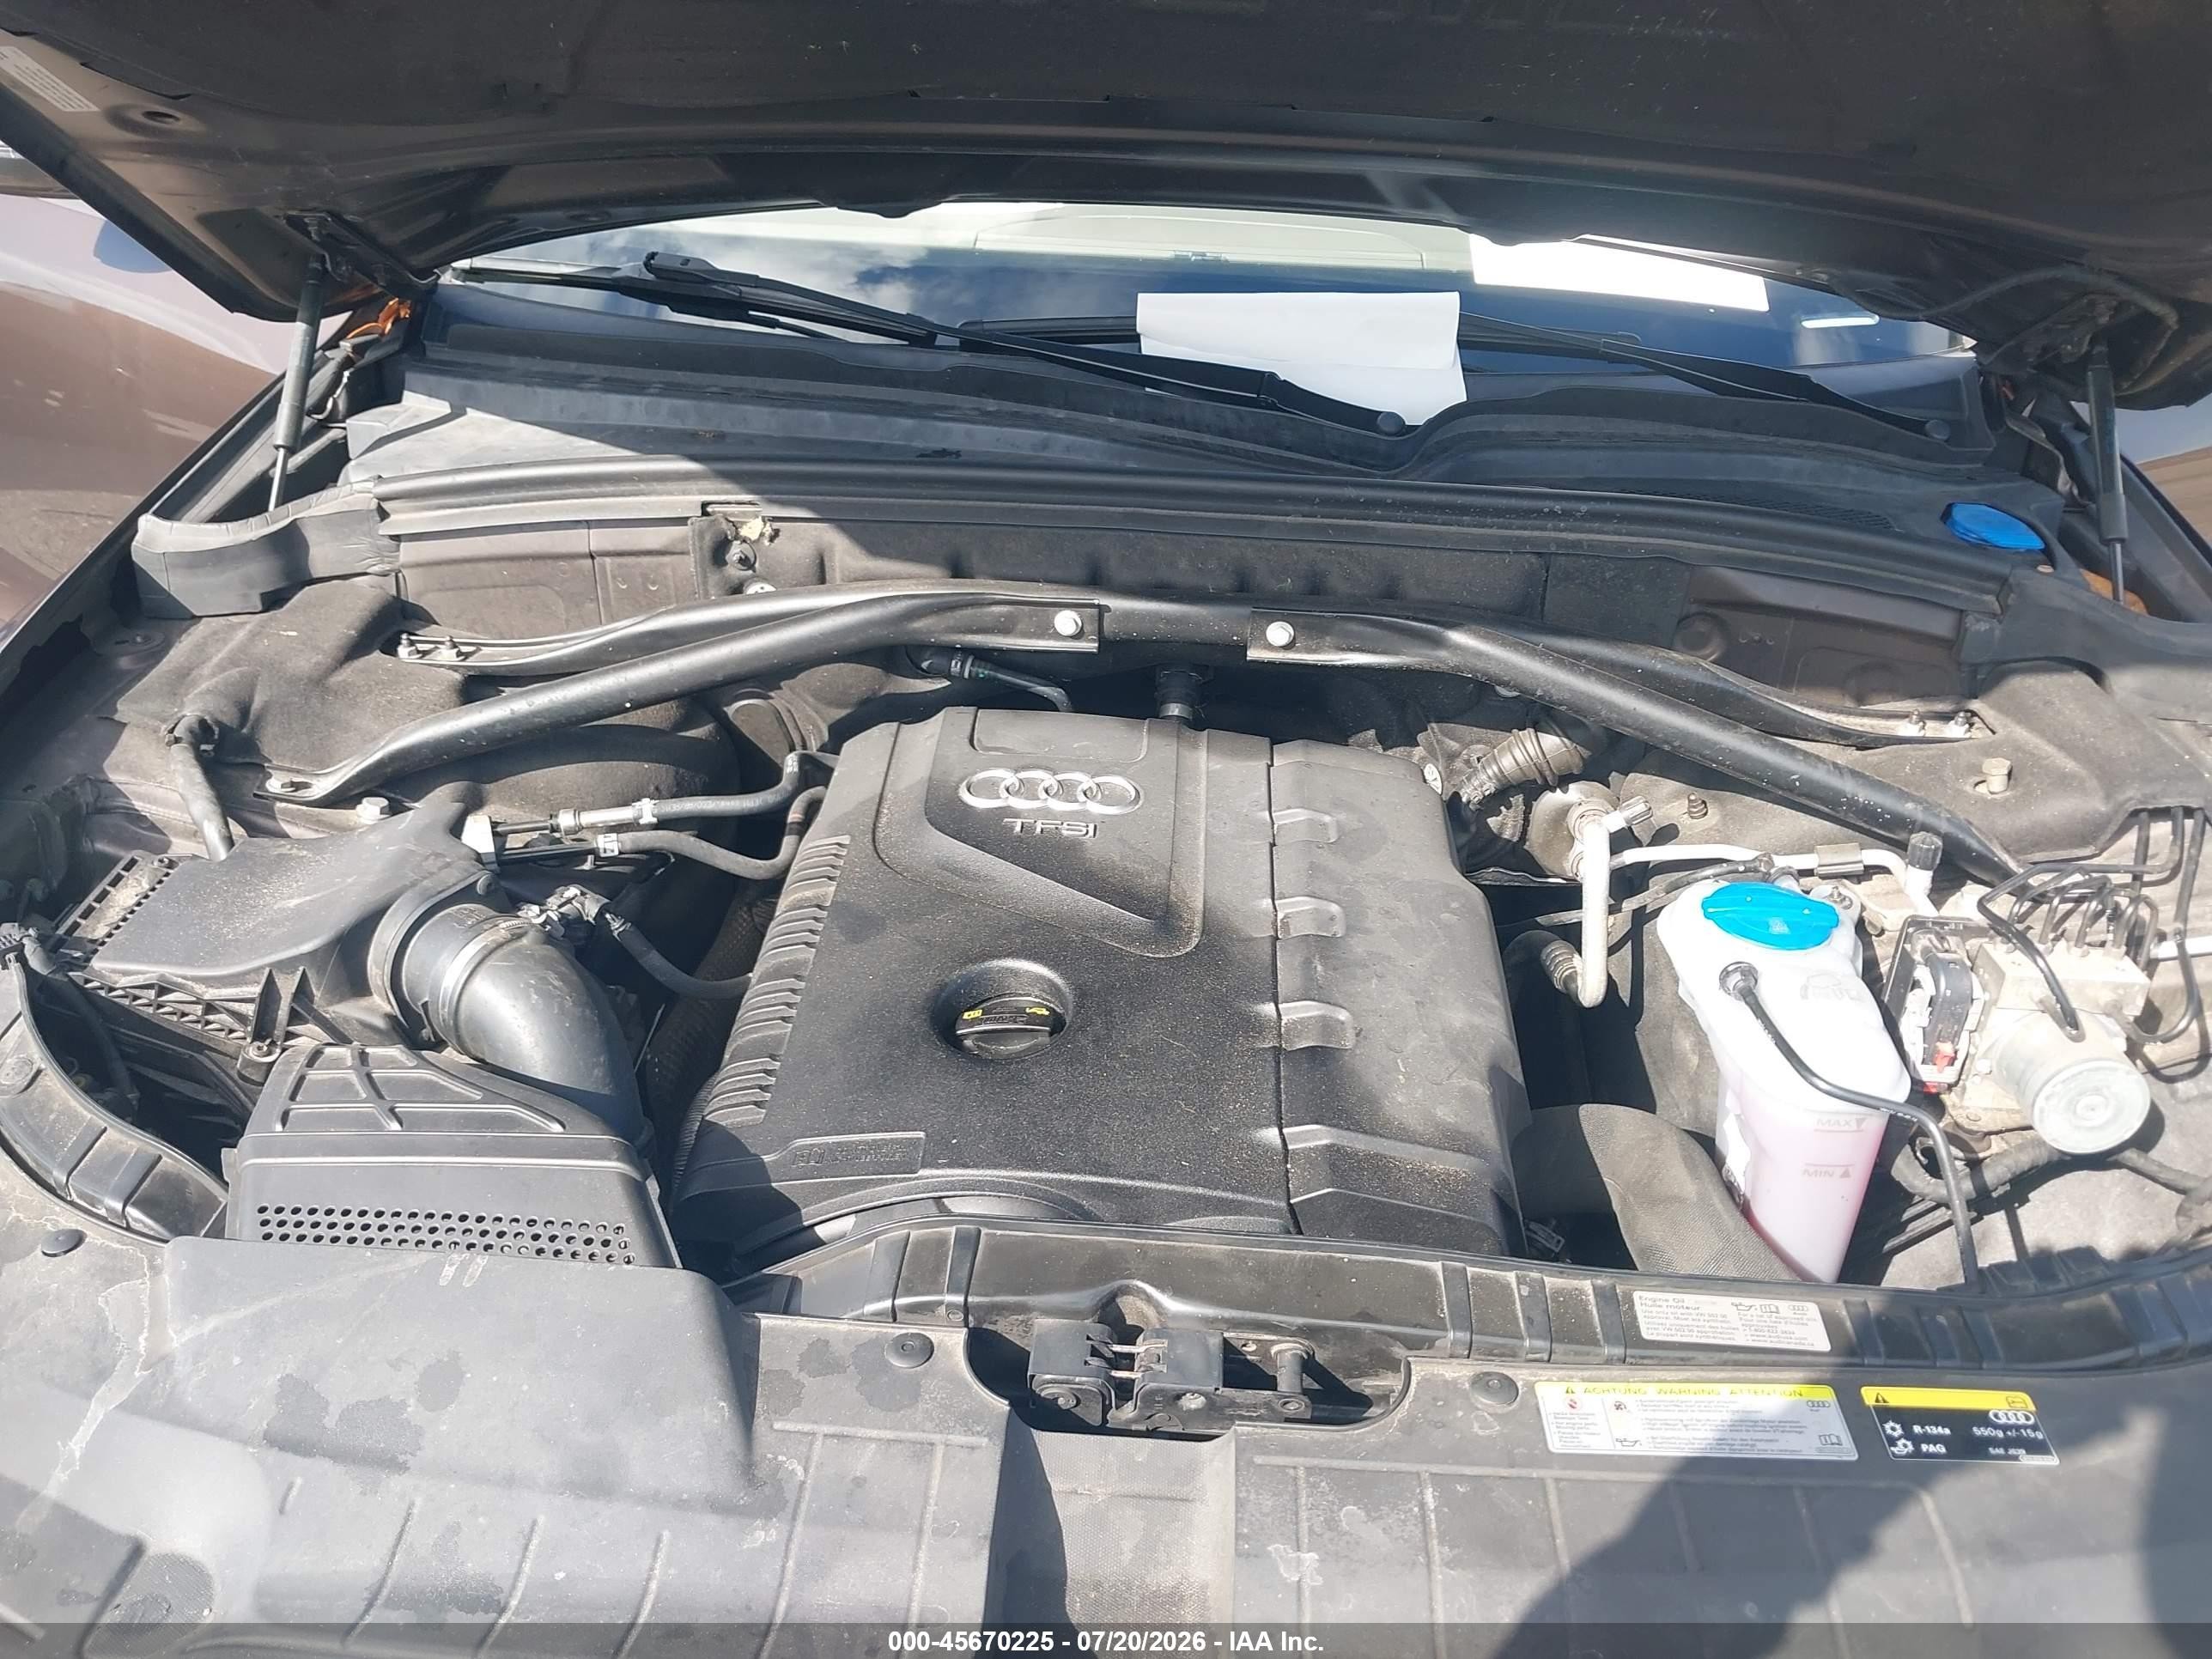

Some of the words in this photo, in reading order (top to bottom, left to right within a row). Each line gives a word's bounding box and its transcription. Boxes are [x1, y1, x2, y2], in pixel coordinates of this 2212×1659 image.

[1003, 817, 1098, 839] TFSI
[1802, 1169, 1835, 1177] MIN
[1583, 1387, 1647, 1395] ACHTUNG
[1656, 1388, 1721, 1396] WARNING
[1912, 1425, 1951, 1435] R-134a
[1972, 1426, 2003, 1437] 550g
[1921, 1443, 1947, 1453] PAG
